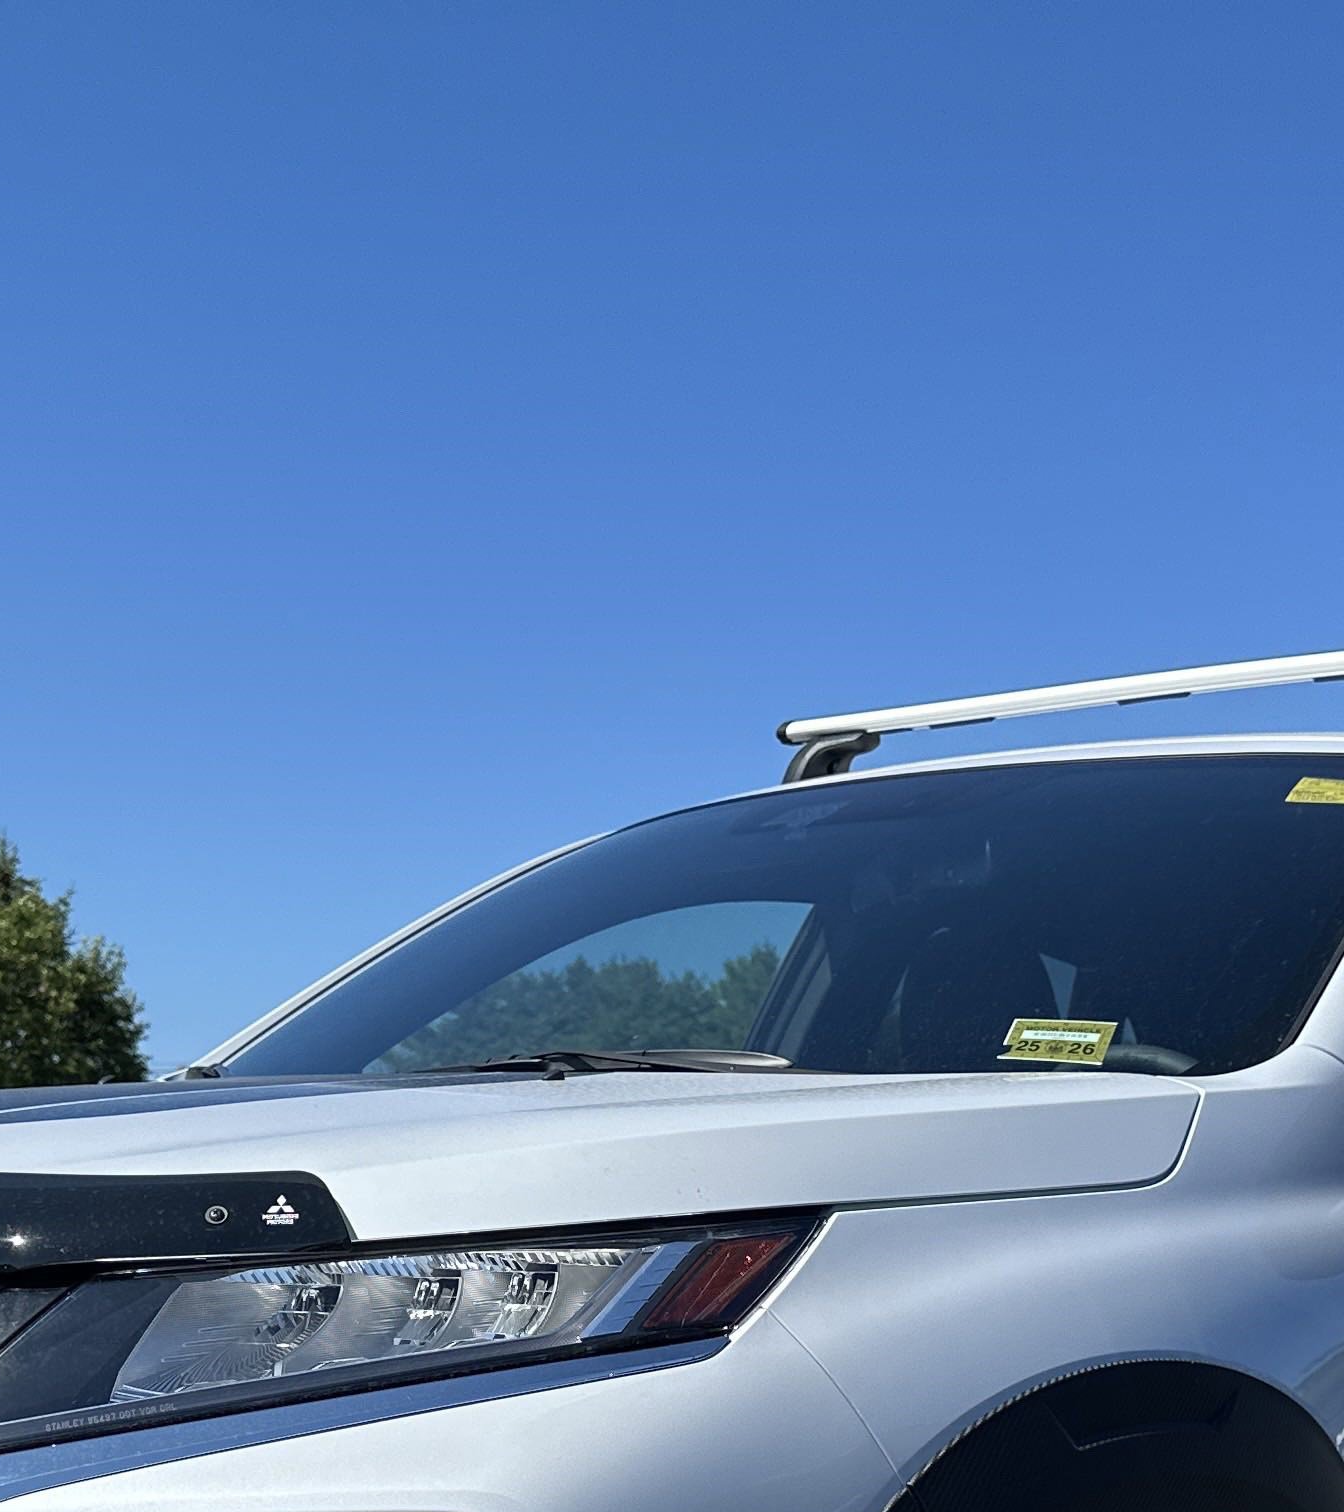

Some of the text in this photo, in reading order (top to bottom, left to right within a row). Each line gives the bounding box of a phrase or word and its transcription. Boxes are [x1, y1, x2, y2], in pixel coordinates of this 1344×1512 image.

[1015, 1040, 1096, 1055] 25 26
[45, 1417, 85, 1433] STANLEY
[119, 1408, 136, 1420] DOT
